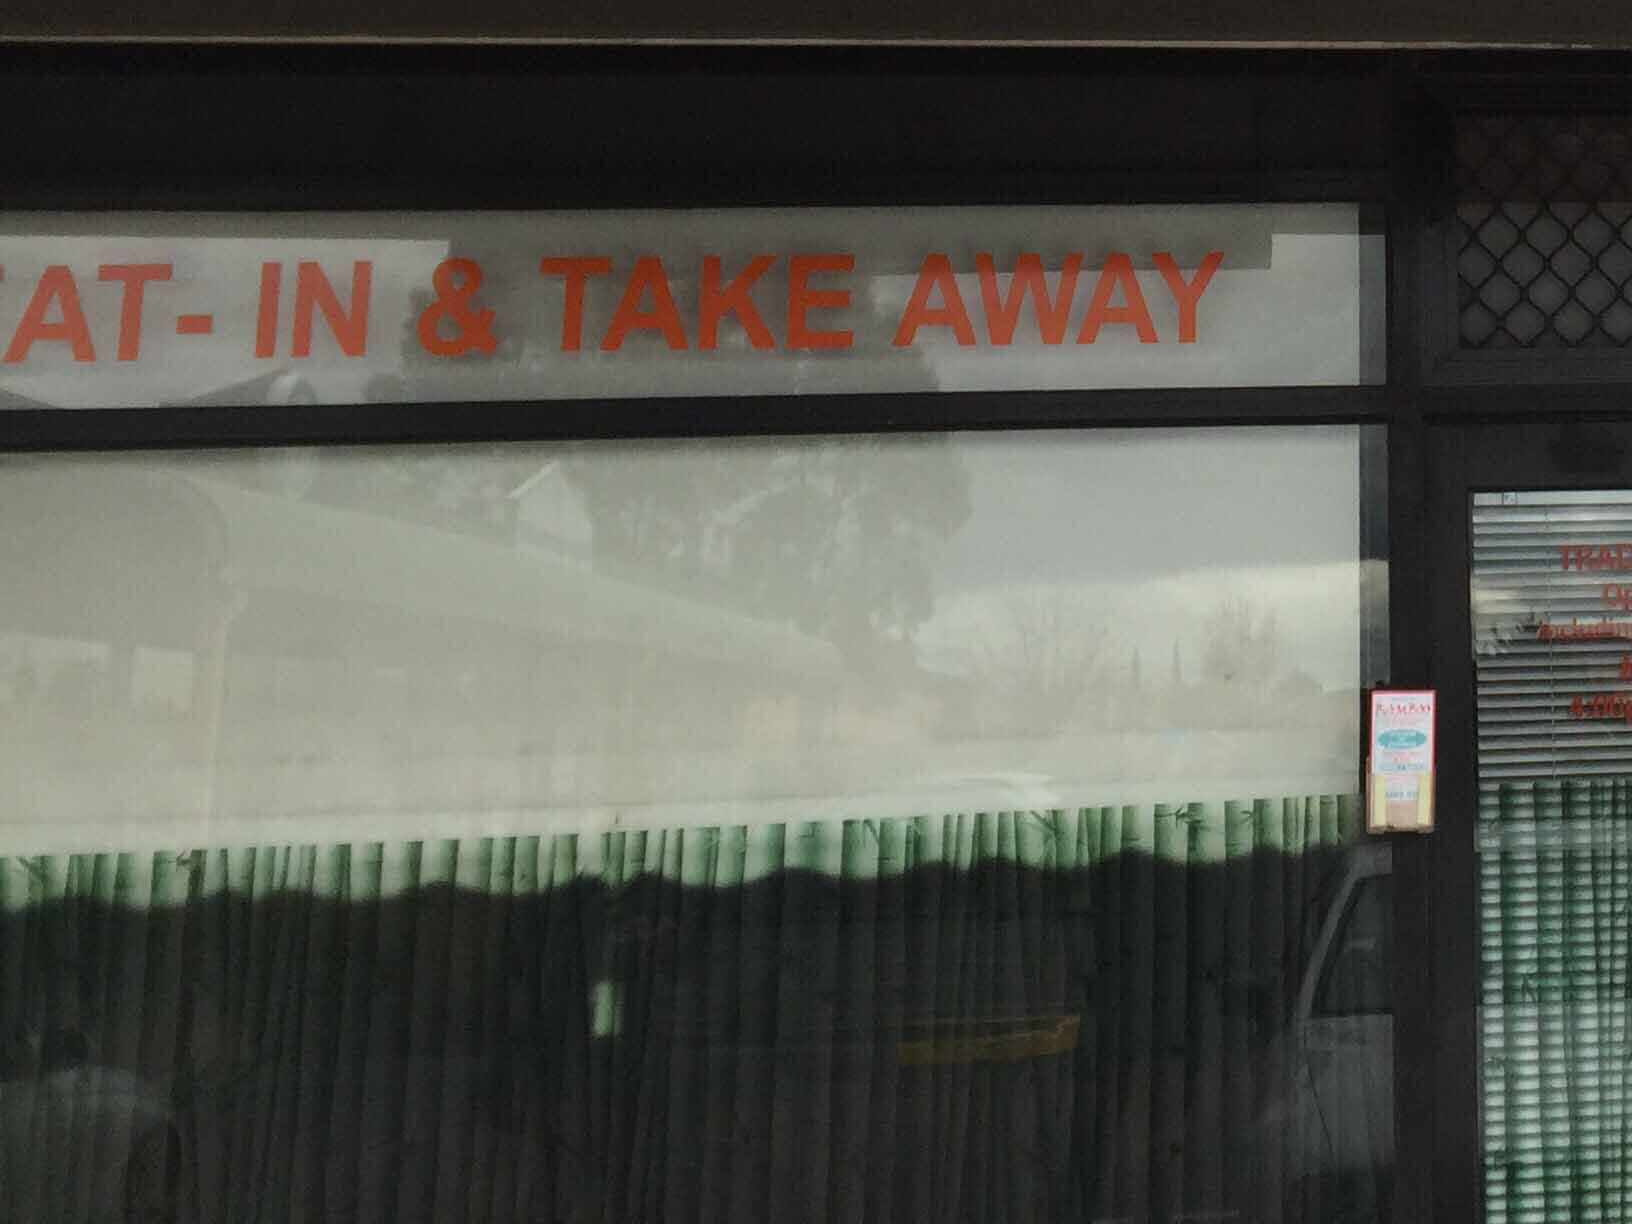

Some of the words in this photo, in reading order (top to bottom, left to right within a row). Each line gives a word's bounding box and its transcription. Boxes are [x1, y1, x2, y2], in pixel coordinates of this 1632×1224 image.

[0, 262, 214, 364] AT-
[254, 260, 374, 359] IN
[417, 255, 498, 356] &
[540, 254, 856, 354] TAKE
[890, 250, 1226, 349] AWAY
